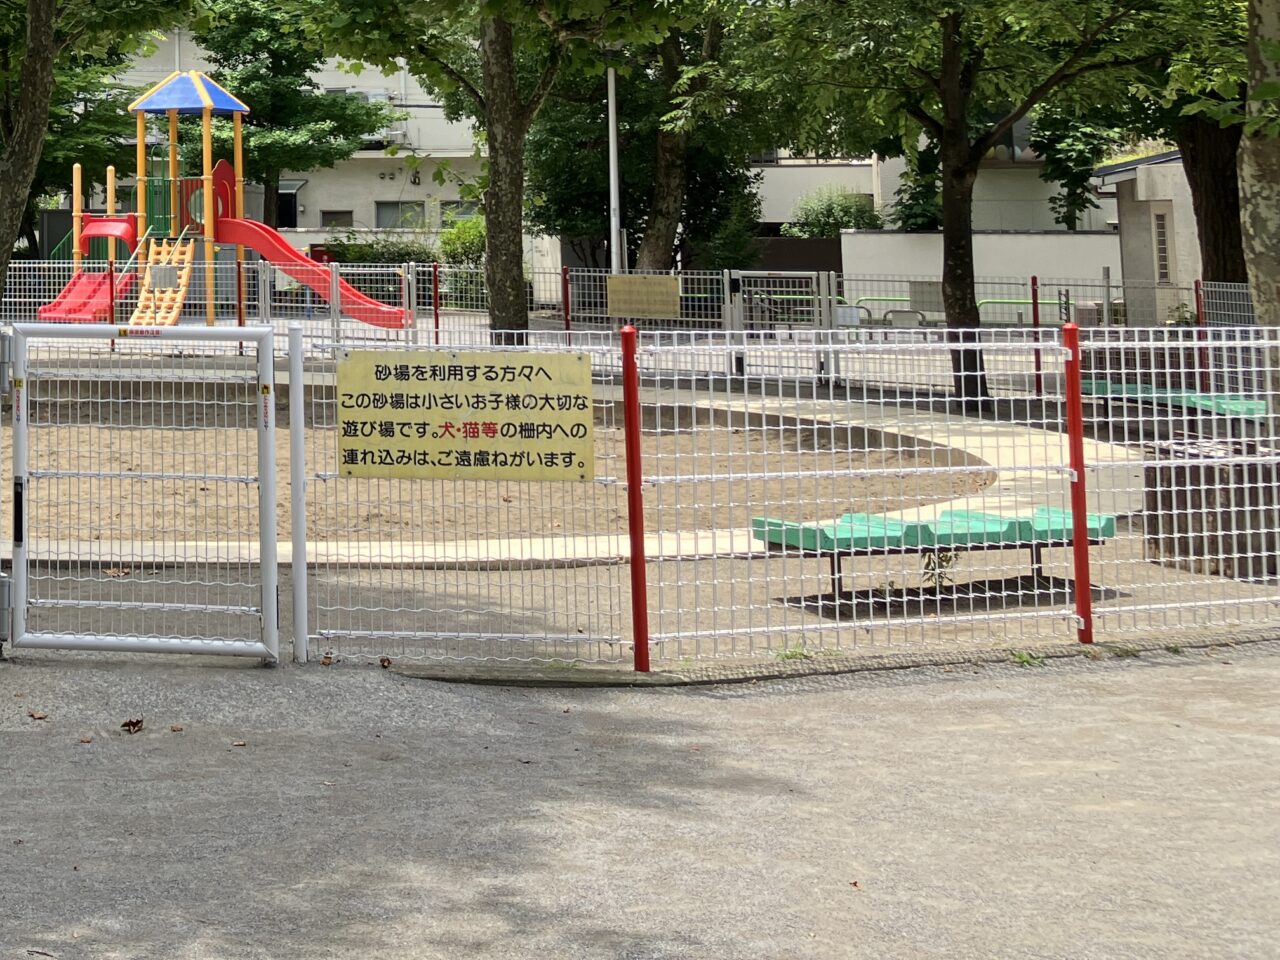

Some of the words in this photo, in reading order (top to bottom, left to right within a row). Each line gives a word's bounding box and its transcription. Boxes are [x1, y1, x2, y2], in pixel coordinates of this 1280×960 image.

[374, 364, 553, 382] 砂場を利用する方々へ
[341, 392, 589, 411] この砂場は小さいお子様の大切な
[342, 448, 586, 469] 連れ込みは、ご遠慮ねがいます。
